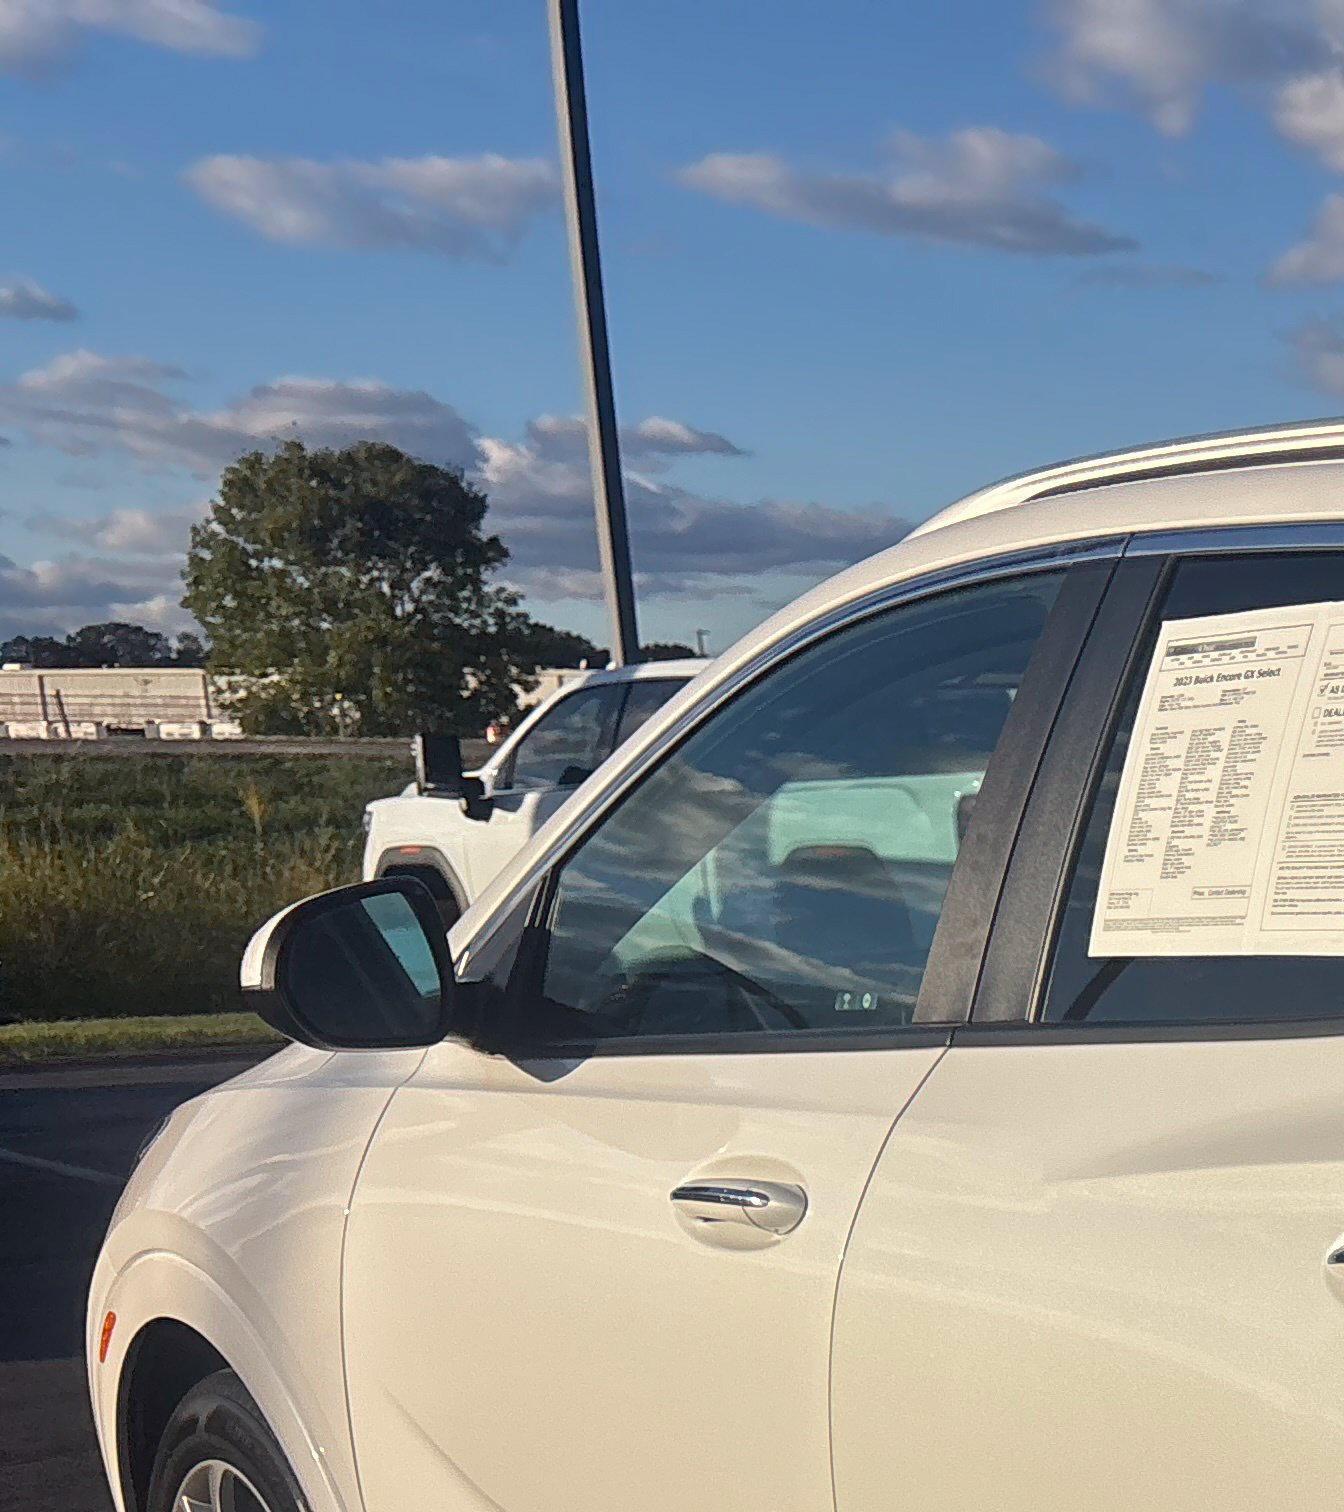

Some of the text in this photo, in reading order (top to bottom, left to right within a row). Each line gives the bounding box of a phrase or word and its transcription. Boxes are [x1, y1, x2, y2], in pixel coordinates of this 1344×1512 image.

[1173, 667, 1282, 687] 2023 Buick Encore GX Select
